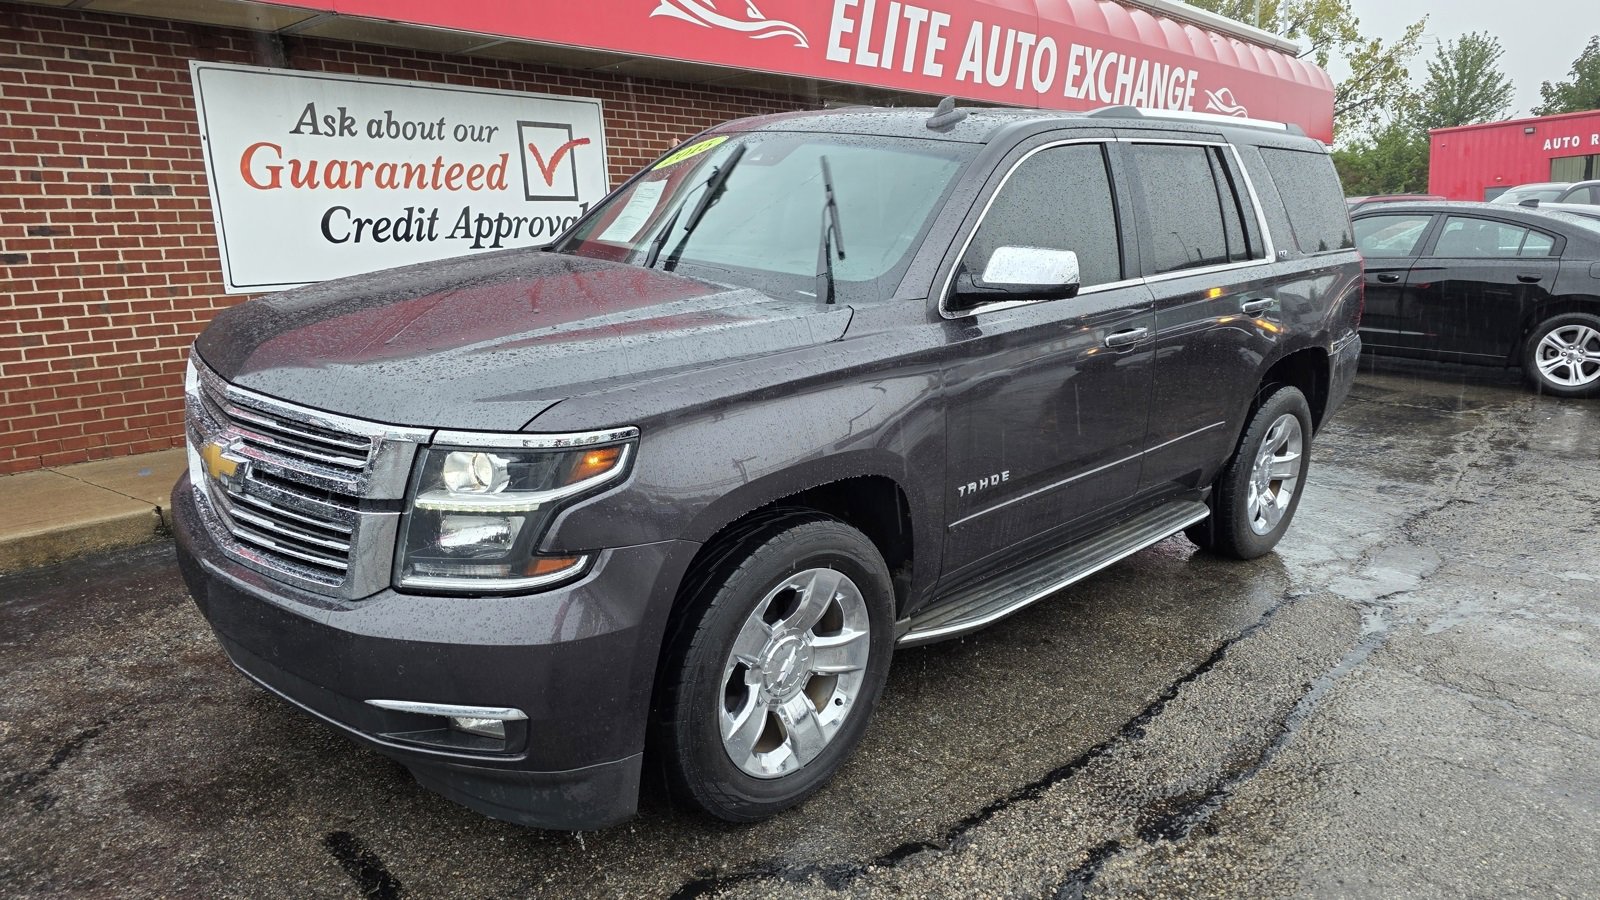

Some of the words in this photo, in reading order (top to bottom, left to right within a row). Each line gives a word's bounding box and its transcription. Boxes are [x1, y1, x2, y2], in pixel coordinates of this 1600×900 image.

[826, 0, 951, 77] ELITE
[955, 20, 1058, 94] AUTO
[1064, 43, 1199, 112] EXCHANGE
[289, 102, 358, 137] Ask
[367, 111, 446, 141] about
[454, 123, 499, 143] our
[1543, 136, 1580, 150] AUTO
[240, 142, 510, 191] Guaranteed
[321, 205, 439, 243] Credit
[958, 470, 1010, 497] TAHOE
